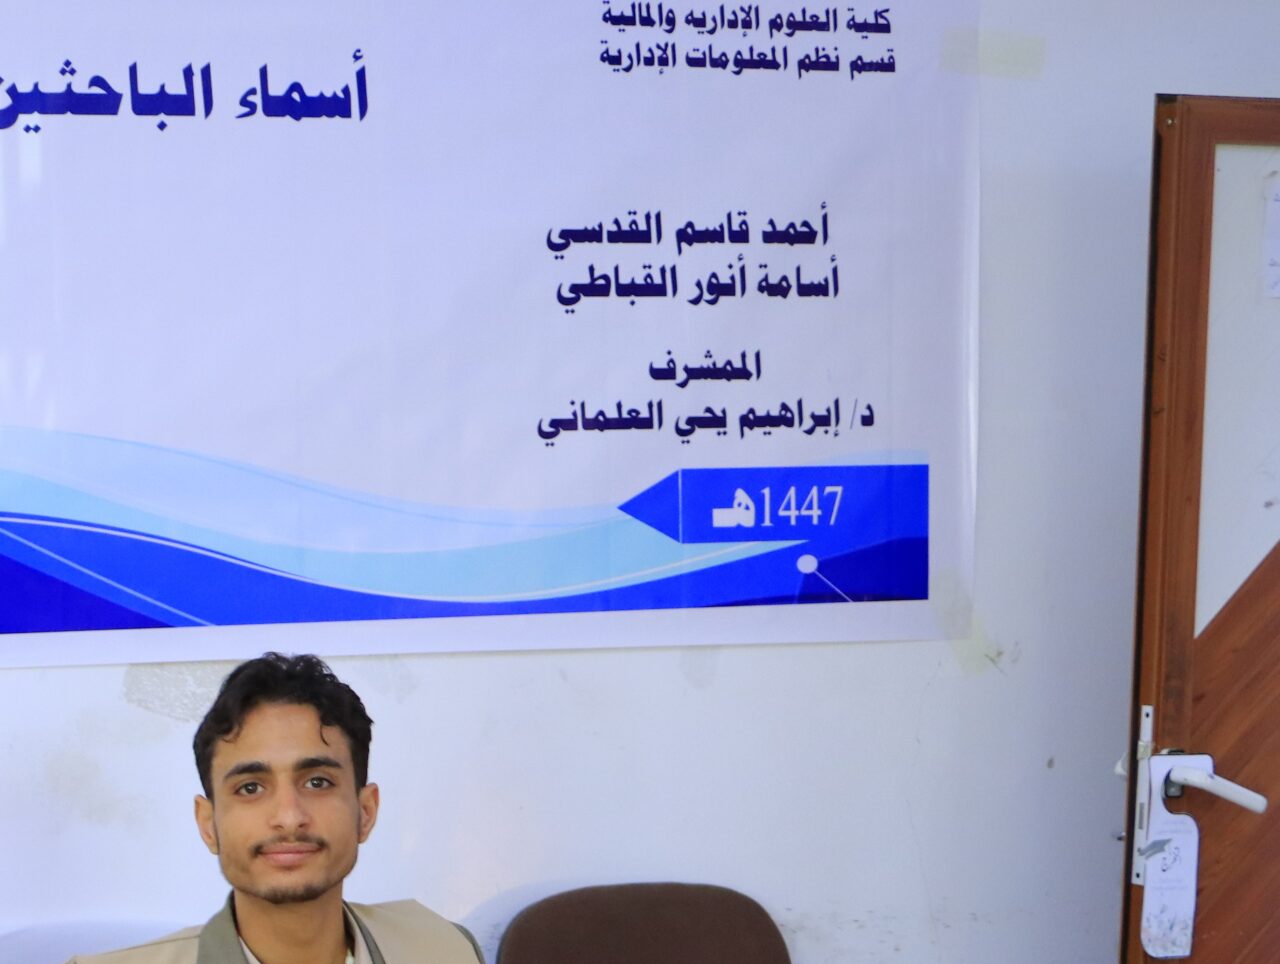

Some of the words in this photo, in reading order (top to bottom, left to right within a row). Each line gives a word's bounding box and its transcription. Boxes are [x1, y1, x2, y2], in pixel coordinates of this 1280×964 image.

[601, 0, 677, 34] والمالية
[768, 7, 838, 39] العلوم
[846, 7, 892, 40] كلية
[599, 40, 677, 75] الإدارية
[685, 43, 788, 76] المعلومات
[796, 46, 840, 80] نظم
[849, 48, 896, 81] قسم
[235, 48, 369, 122] أسماء
[546, 210, 663, 260] القدسي
[675, 210, 750, 256] قاسم
[761, 202, 829, 246] أحمد
[556, 263, 678, 314] القباطي
[687, 253, 747, 306] أنور
[756, 254, 840, 300] أسامة
[648, 349, 762, 389] المشرف
[537, 399, 664, 447] العلماني
[674, 405, 728, 445] يحي
[738, 397, 841, 440] إبراهيم
